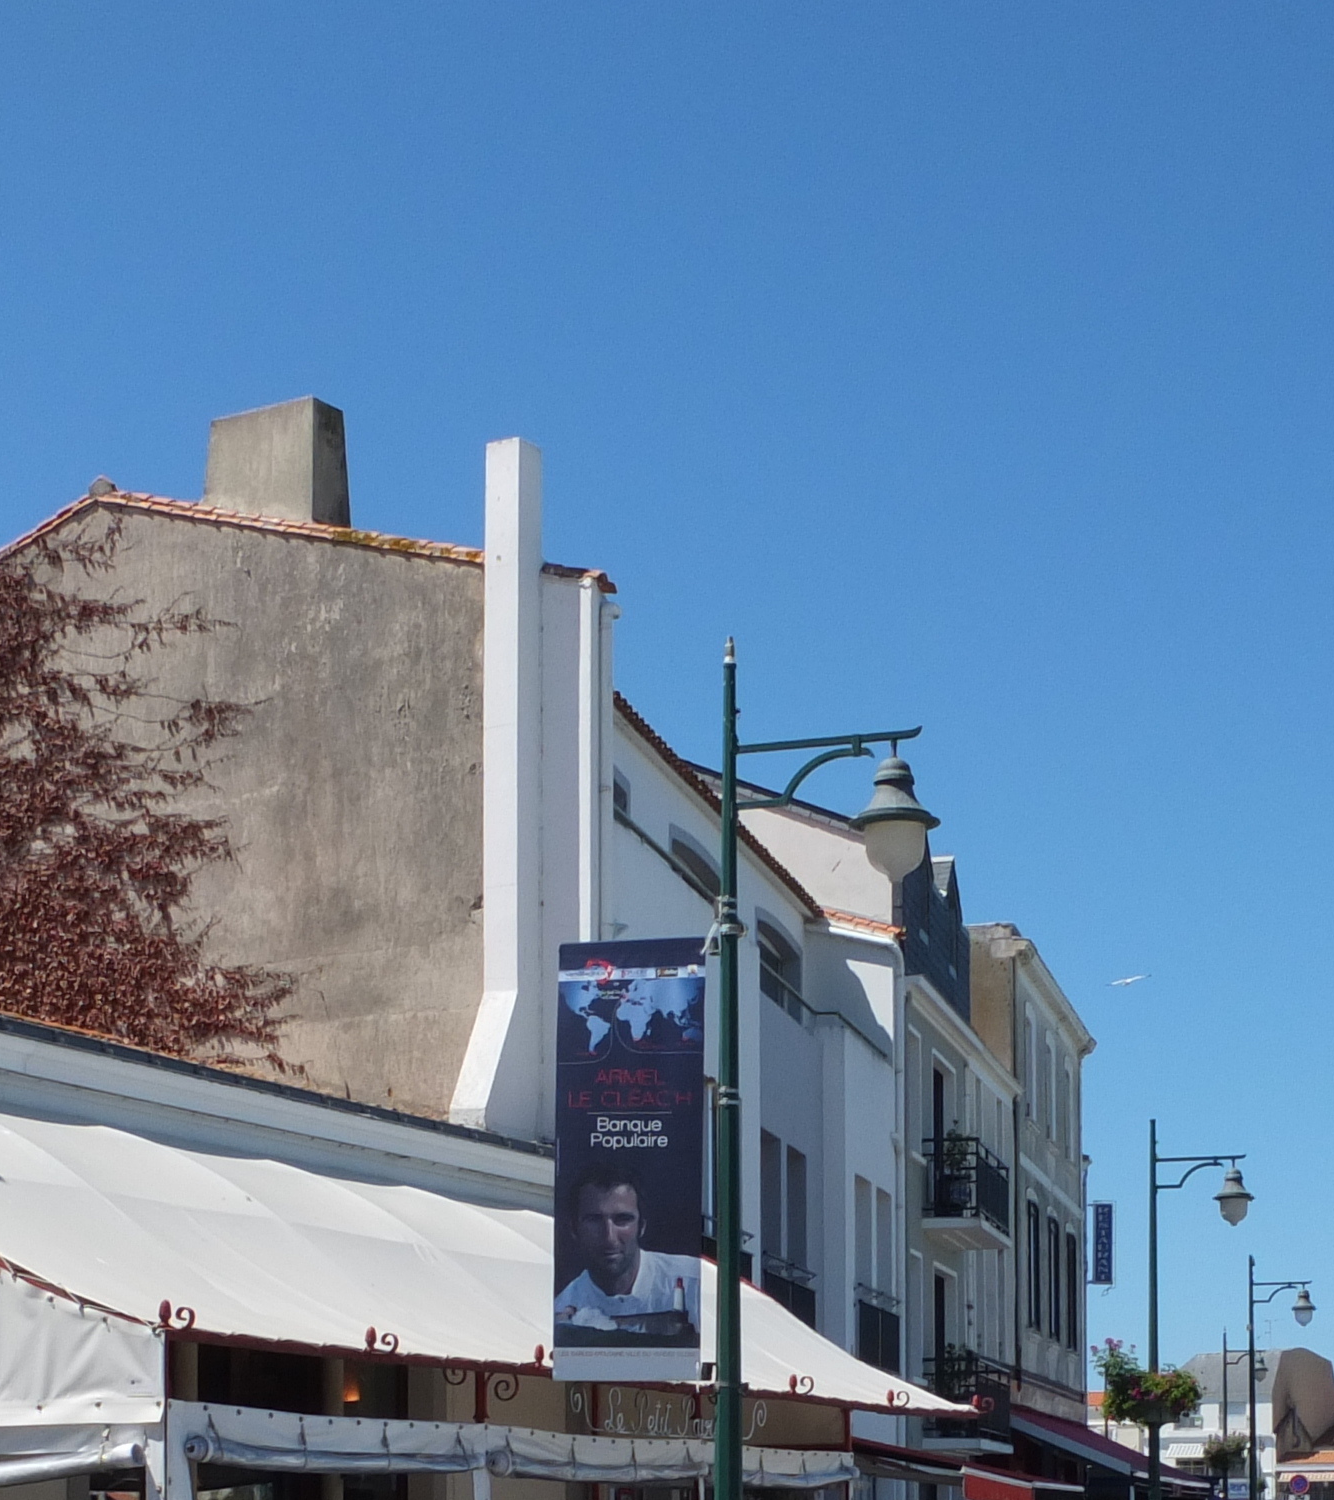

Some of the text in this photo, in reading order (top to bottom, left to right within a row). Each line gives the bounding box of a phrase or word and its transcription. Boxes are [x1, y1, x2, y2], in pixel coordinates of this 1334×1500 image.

[595, 1068, 666, 1085] ARMEL
[568, 1091, 592, 1108] LE
[596, 1116, 663, 1133] Banque
[590, 1133, 669, 1150] Populaire
[604, 1386, 625, 1432] Le
[630, 1389, 672, 1435] Petit
